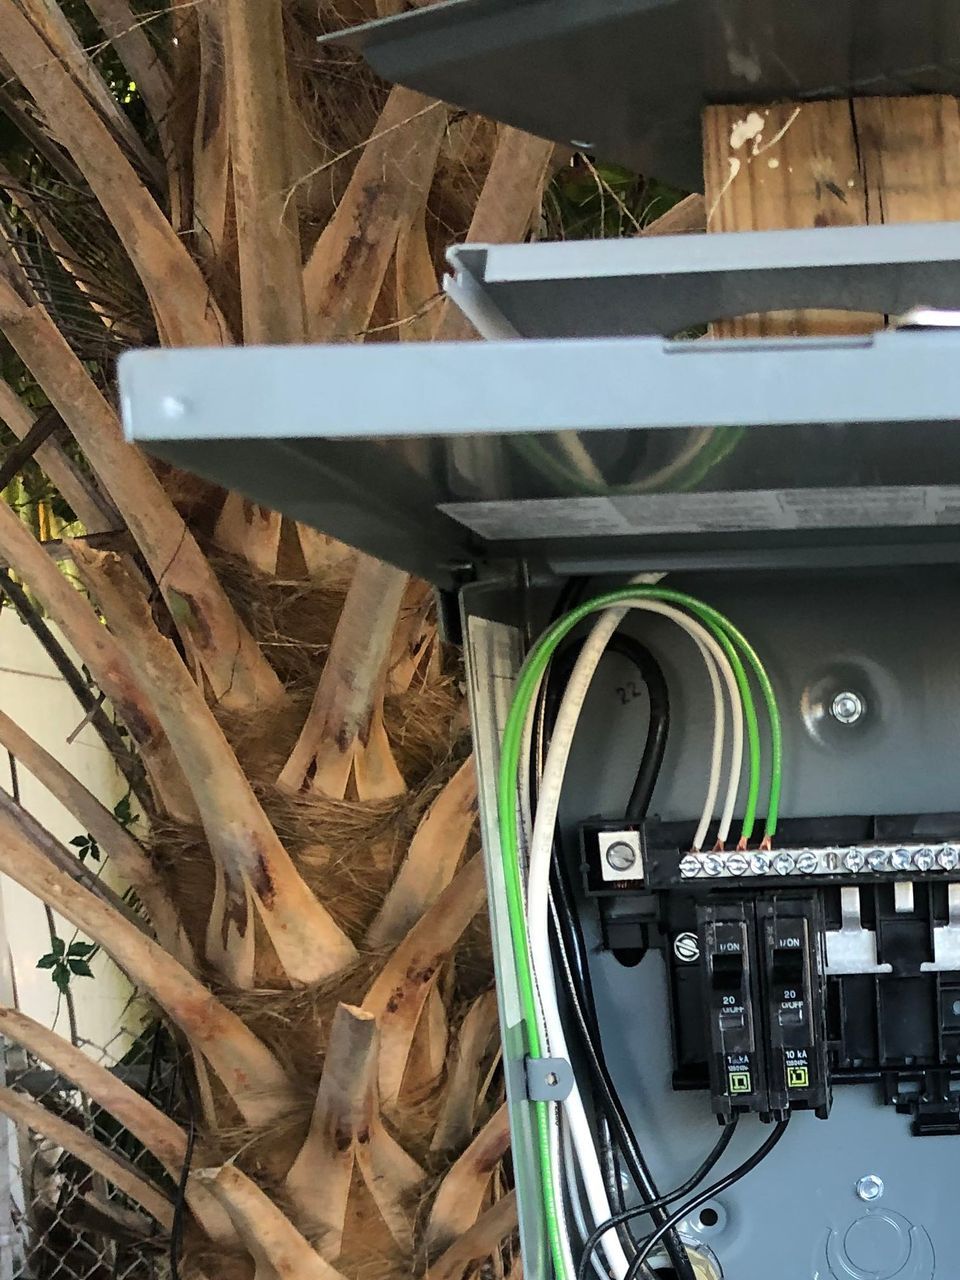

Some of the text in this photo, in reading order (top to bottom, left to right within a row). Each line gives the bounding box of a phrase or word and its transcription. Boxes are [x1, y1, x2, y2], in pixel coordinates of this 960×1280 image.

[784, 990, 796, 999] 20
[722, 996, 735, 1005] 20
[785, 1049, 808, 1059] 10 kA
